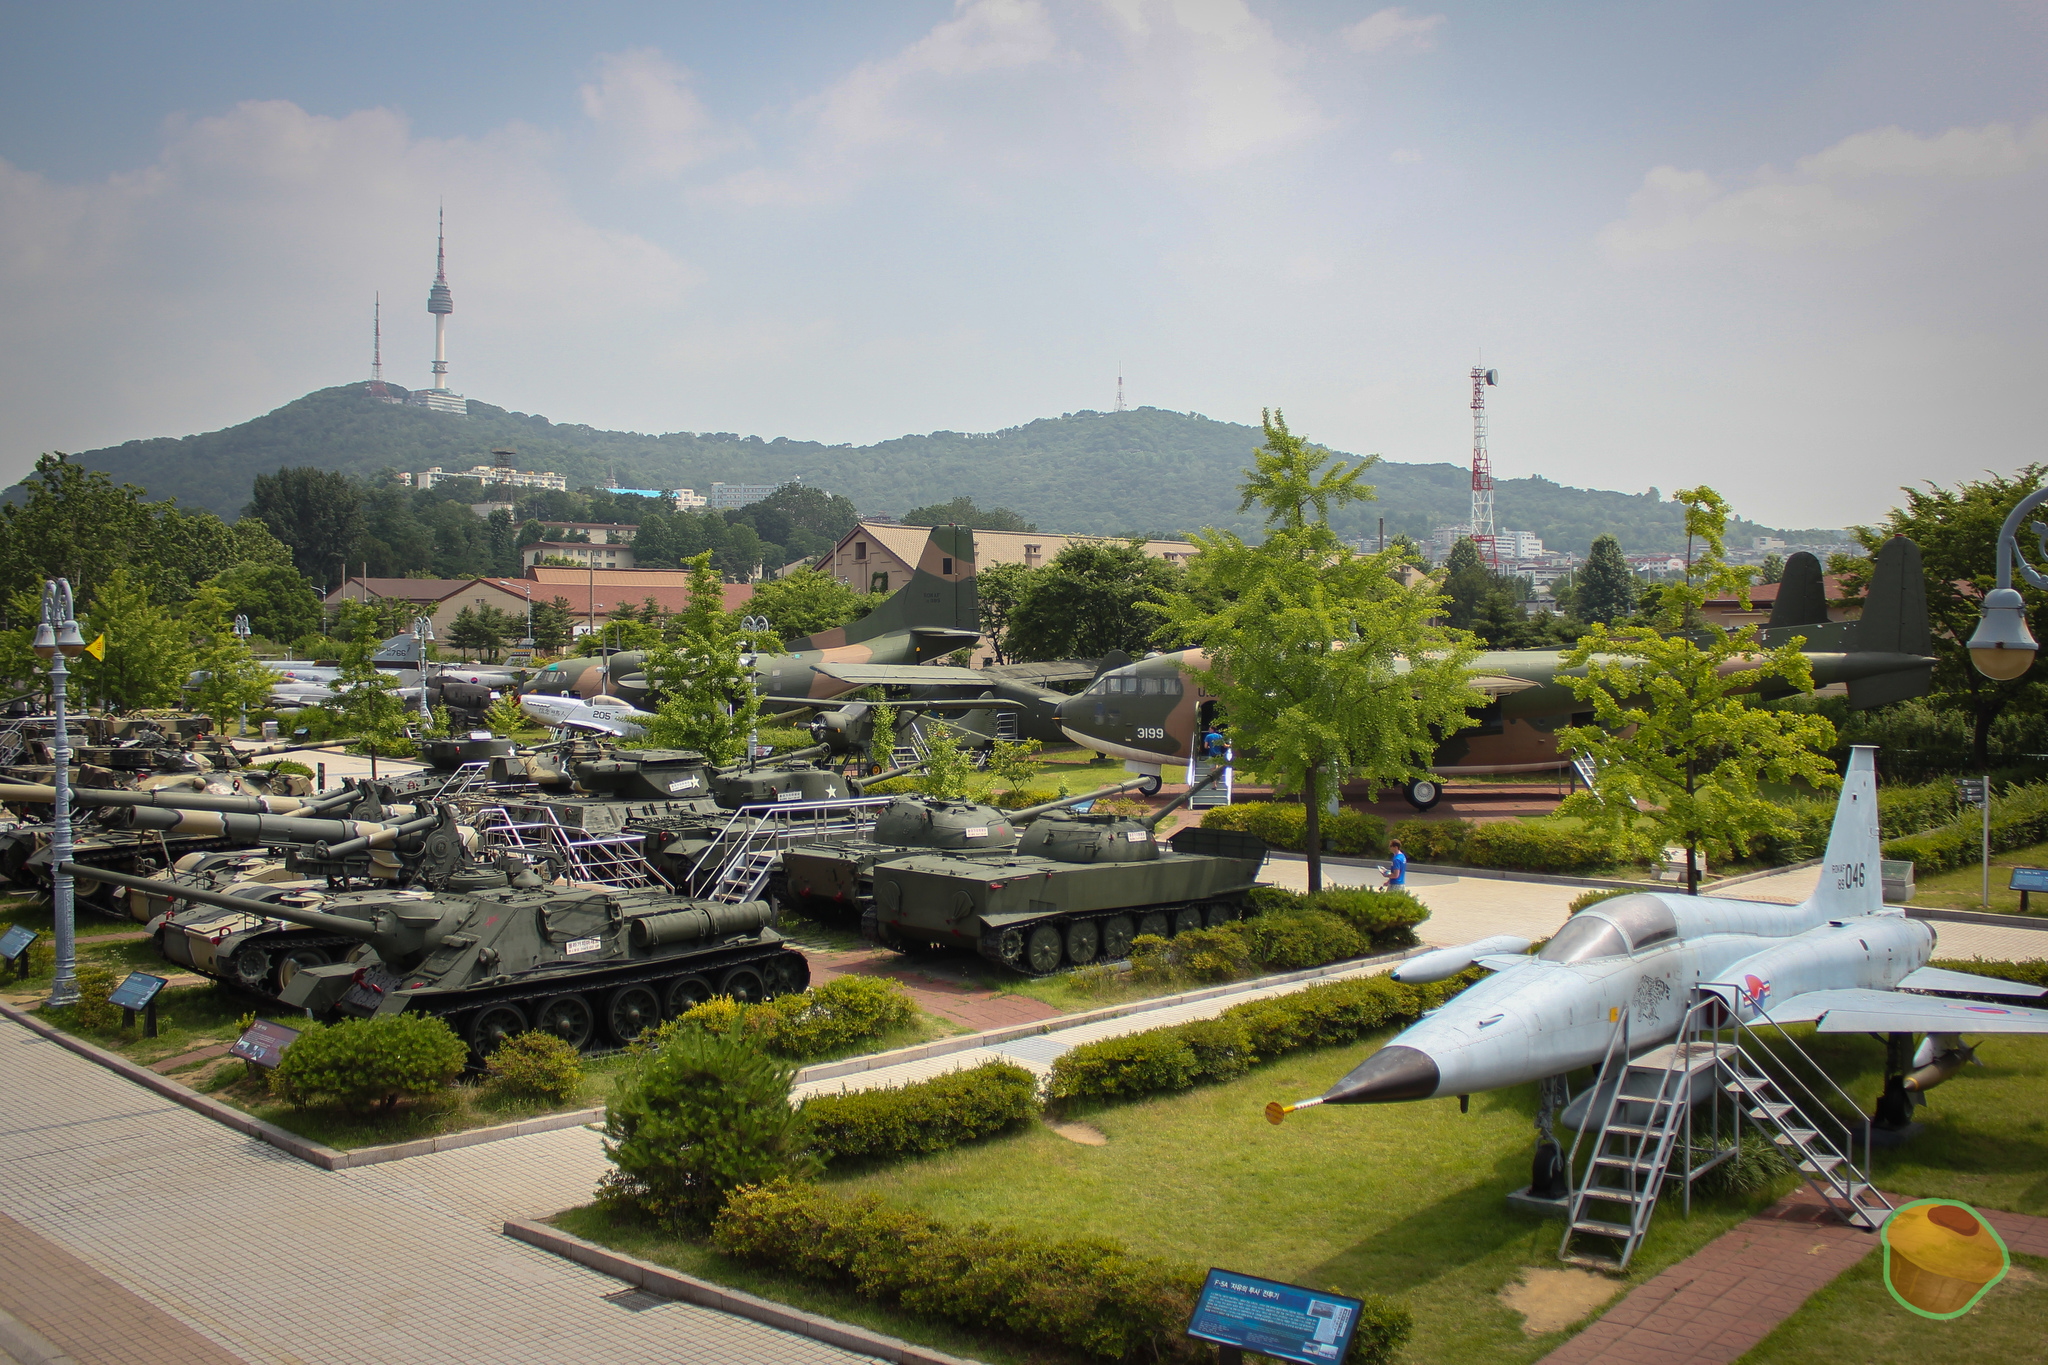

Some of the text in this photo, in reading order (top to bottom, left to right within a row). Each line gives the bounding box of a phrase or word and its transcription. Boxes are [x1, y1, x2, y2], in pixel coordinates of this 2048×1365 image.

[592, 710, 611, 720] 205
[1137, 727, 1164, 739] 3199
[1845, 862, 1865, 889] 046
[1214, 1279, 1228, 1288] F-5A
[1262, 1289, 1280, 1300] 전투기
